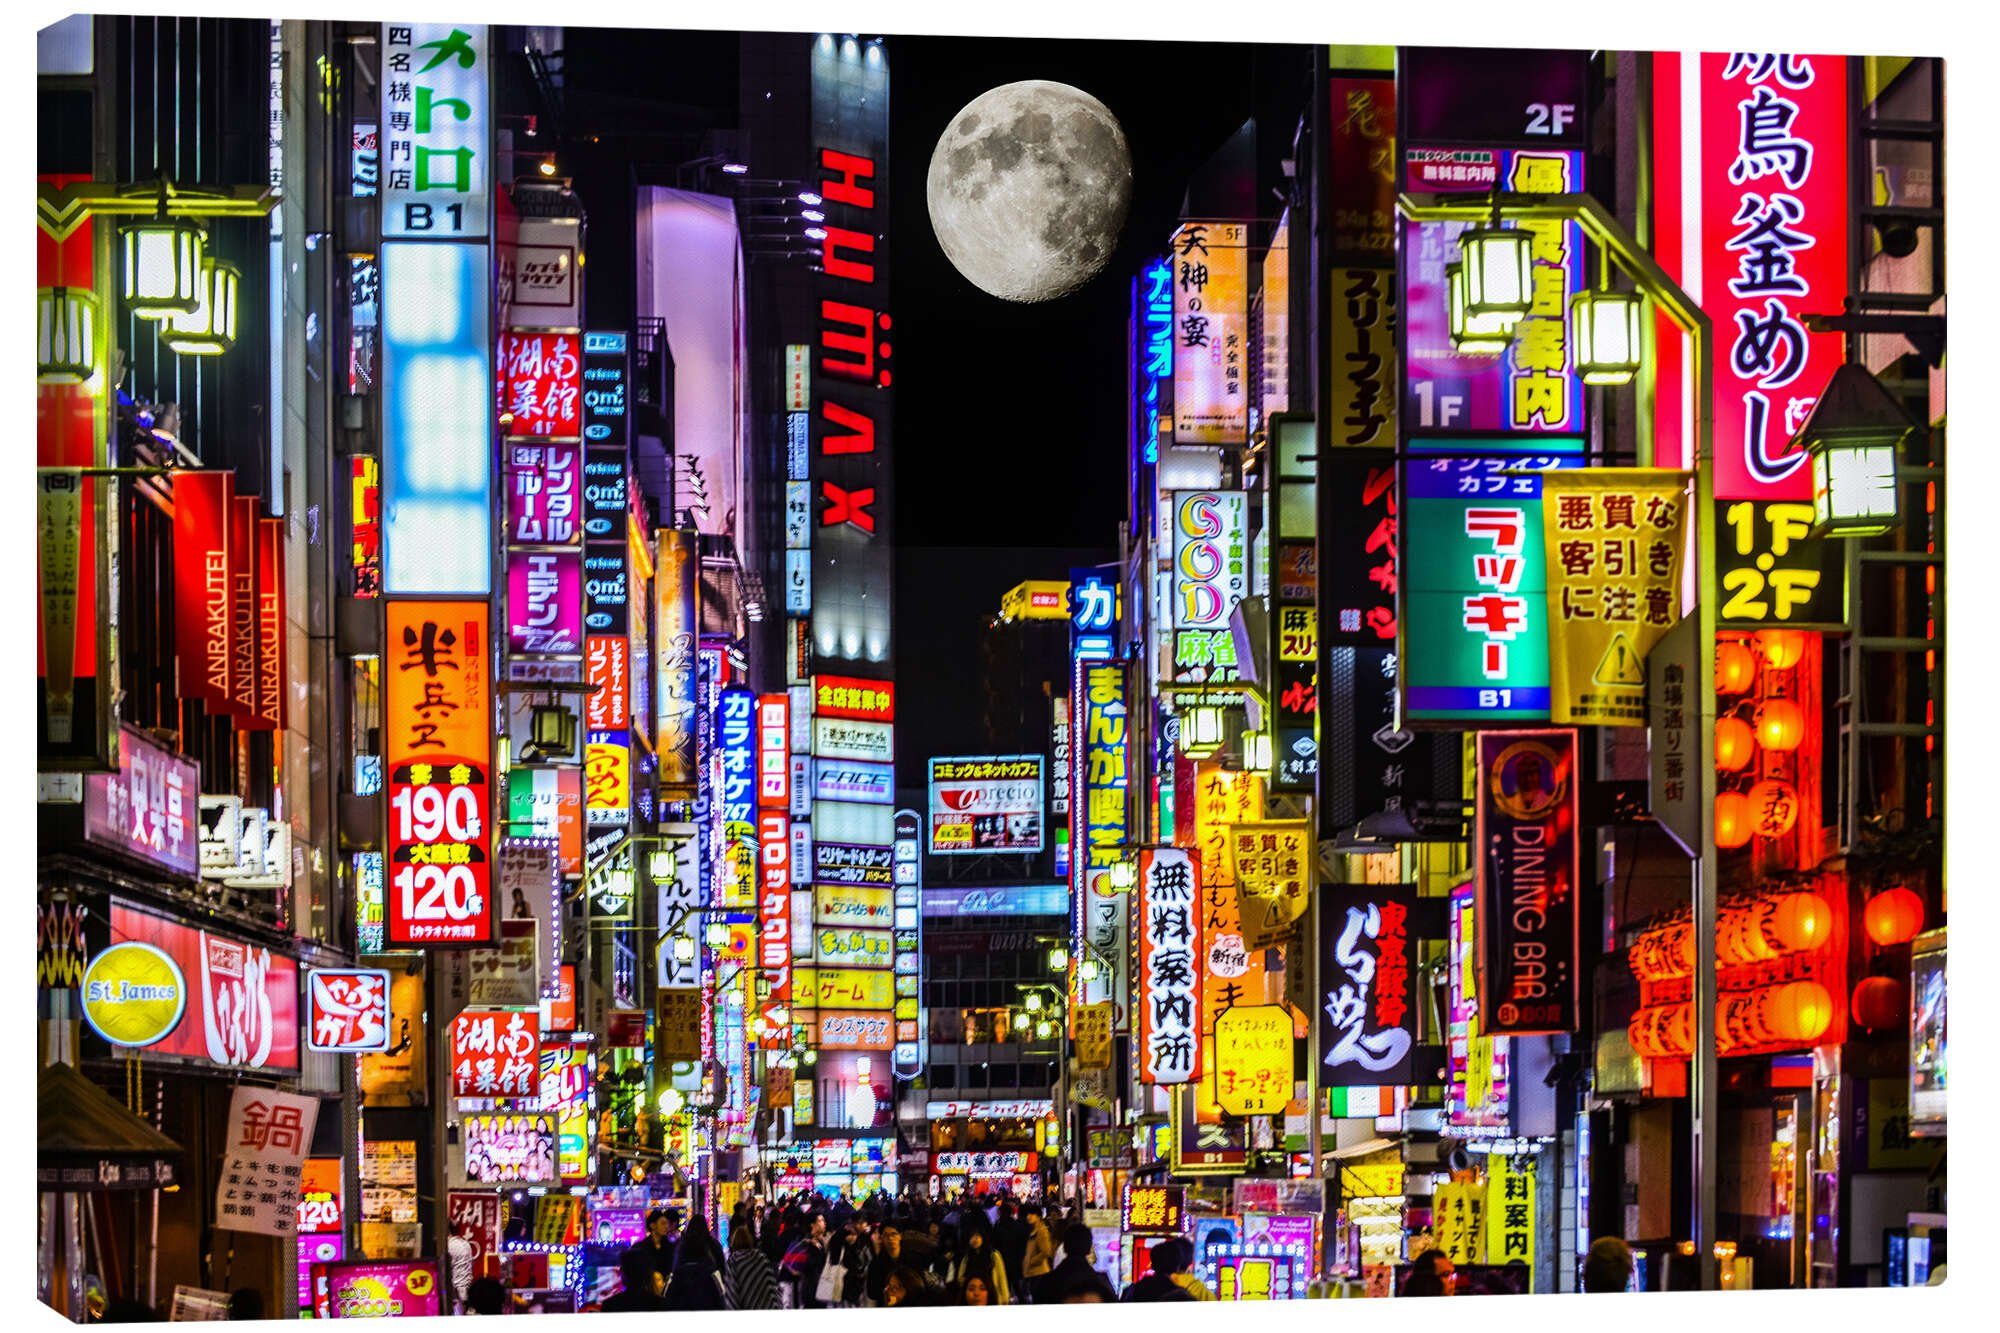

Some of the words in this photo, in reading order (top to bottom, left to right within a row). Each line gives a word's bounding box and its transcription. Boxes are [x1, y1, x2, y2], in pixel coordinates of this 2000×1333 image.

[388, 27, 411, 190] 四名様専門店
[1524, 103, 1575, 135] 2F
[1424, 165, 1495, 182] 無料案内所
[405, 203, 462, 231] B1
[1226, 228, 1242, 240] 5F
[1181, 226, 1209, 348] 天神の宴
[509, 337, 578, 380] 湖南
[510, 381, 578, 421] 菜館
[1414, 382, 1462, 426] 1F
[516, 449, 541, 464] 3F
[516, 471, 543, 541] ルーム
[547, 448, 573, 542] レンタル
[1459, 475, 1534, 494] カフェ
[1558, 494, 1677, 530] 悪質な
[1727, 502, 1816, 555] 1F
[1180, 494, 1224, 623] GOD
[1559, 541, 1674, 576] 客引き
[528, 557, 559, 627] エデン
[1464, 508, 1527, 679] ラッキー
[1562, 586, 1673, 626] に注意
[1722, 569, 1821, 622] 2F
[206, 551, 228, 690] ANRAKUTEI
[235, 573, 255, 708] ANRAKUTEI
[260, 592, 280, 722] ANRAKUTEI
[1175, 632, 1239, 667] 麻雀
[817, 684, 891, 713] 全店営業中
[1478, 690, 1512, 707] B1
[723, 692, 751, 799] カラオケ
[1663, 664, 1686, 802] 劇場通り一番街
[1088, 666, 1126, 868] まんが喫茶
[1239, 834, 1300, 852] 悪質な
[1239, 859, 1300, 876] 客引き
[1512, 827, 1547, 933] DINING
[762, 816, 790, 989] コロッケクラブ
[1151, 860, 1194, 1071] 無料案内所
[1212, 949, 1246, 967] 新宿
[1512, 942, 1547, 1000] BAR
[820, 983, 866, 1001] ゲーム
[456, 1012, 536, 1058] 湖南
[474, 1058, 535, 1097] 菜館
[240, 1100, 304, 1156] 鍋
[817, 1156, 849, 1169] ゲーム
[1203, 1152, 1223, 1164] B1
[223, 1160, 243, 1215] とまと鍋
[240, 1161, 260, 1217] キムチ鍋
